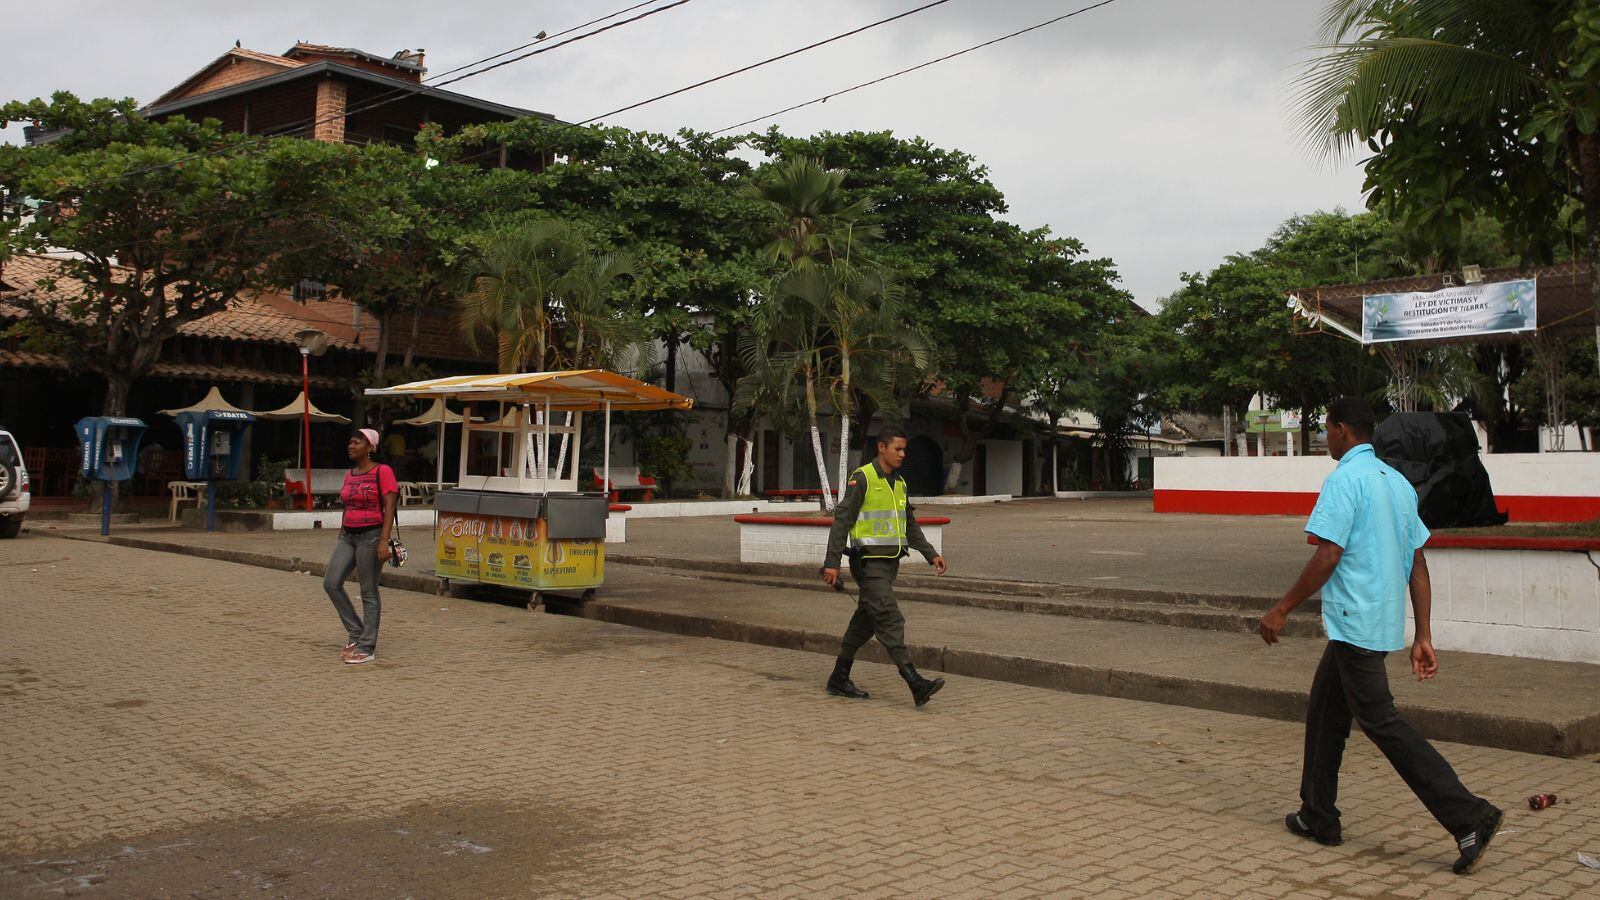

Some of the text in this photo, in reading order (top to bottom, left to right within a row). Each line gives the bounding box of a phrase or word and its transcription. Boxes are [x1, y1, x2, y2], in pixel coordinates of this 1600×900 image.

[1415, 295, 1479, 309] LEY DE VÍCTIMAS Y
[1403, 307, 1449, 318] RESTITUCIÓN
[1449, 305, 1459, 313] DE
